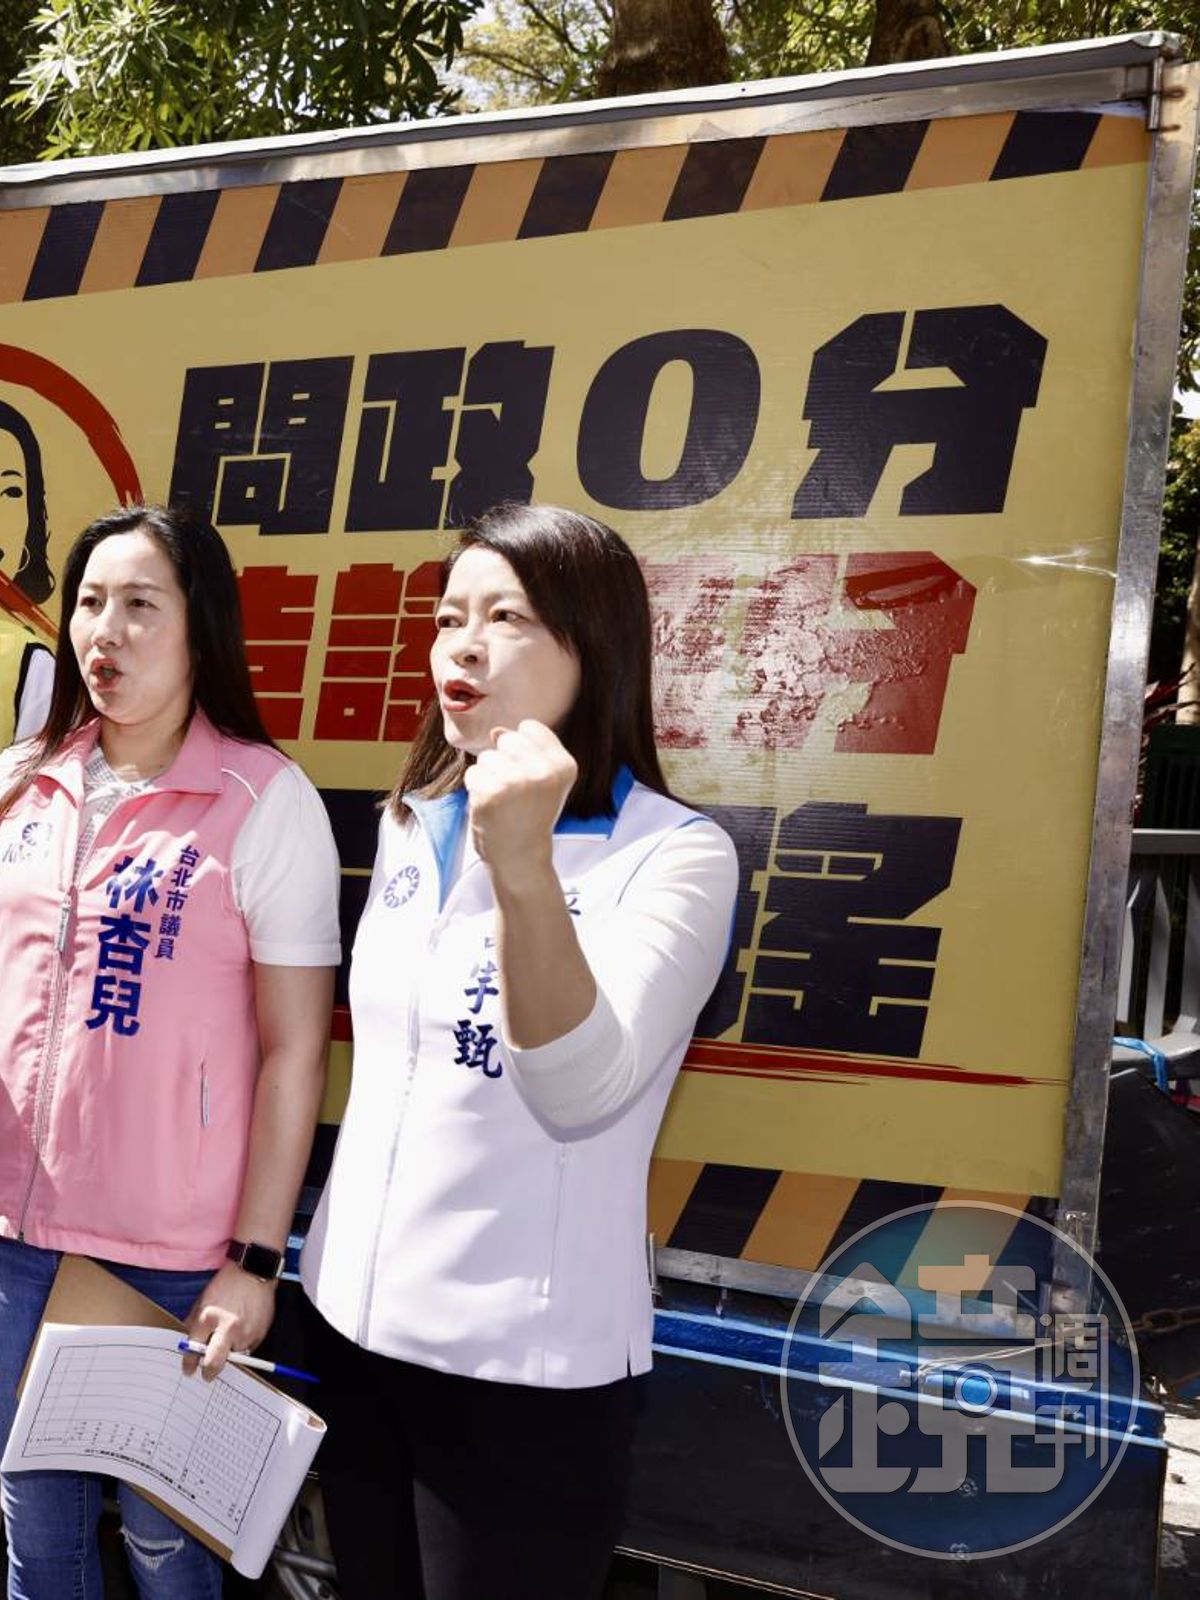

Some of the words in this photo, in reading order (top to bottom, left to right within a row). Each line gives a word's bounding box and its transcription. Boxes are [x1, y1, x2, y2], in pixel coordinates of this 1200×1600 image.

[85, 855, 164, 1037] 林杏兒
[154, 845, 200, 961] 台北市議員
[453, 936, 503, 1079] 宇甄
